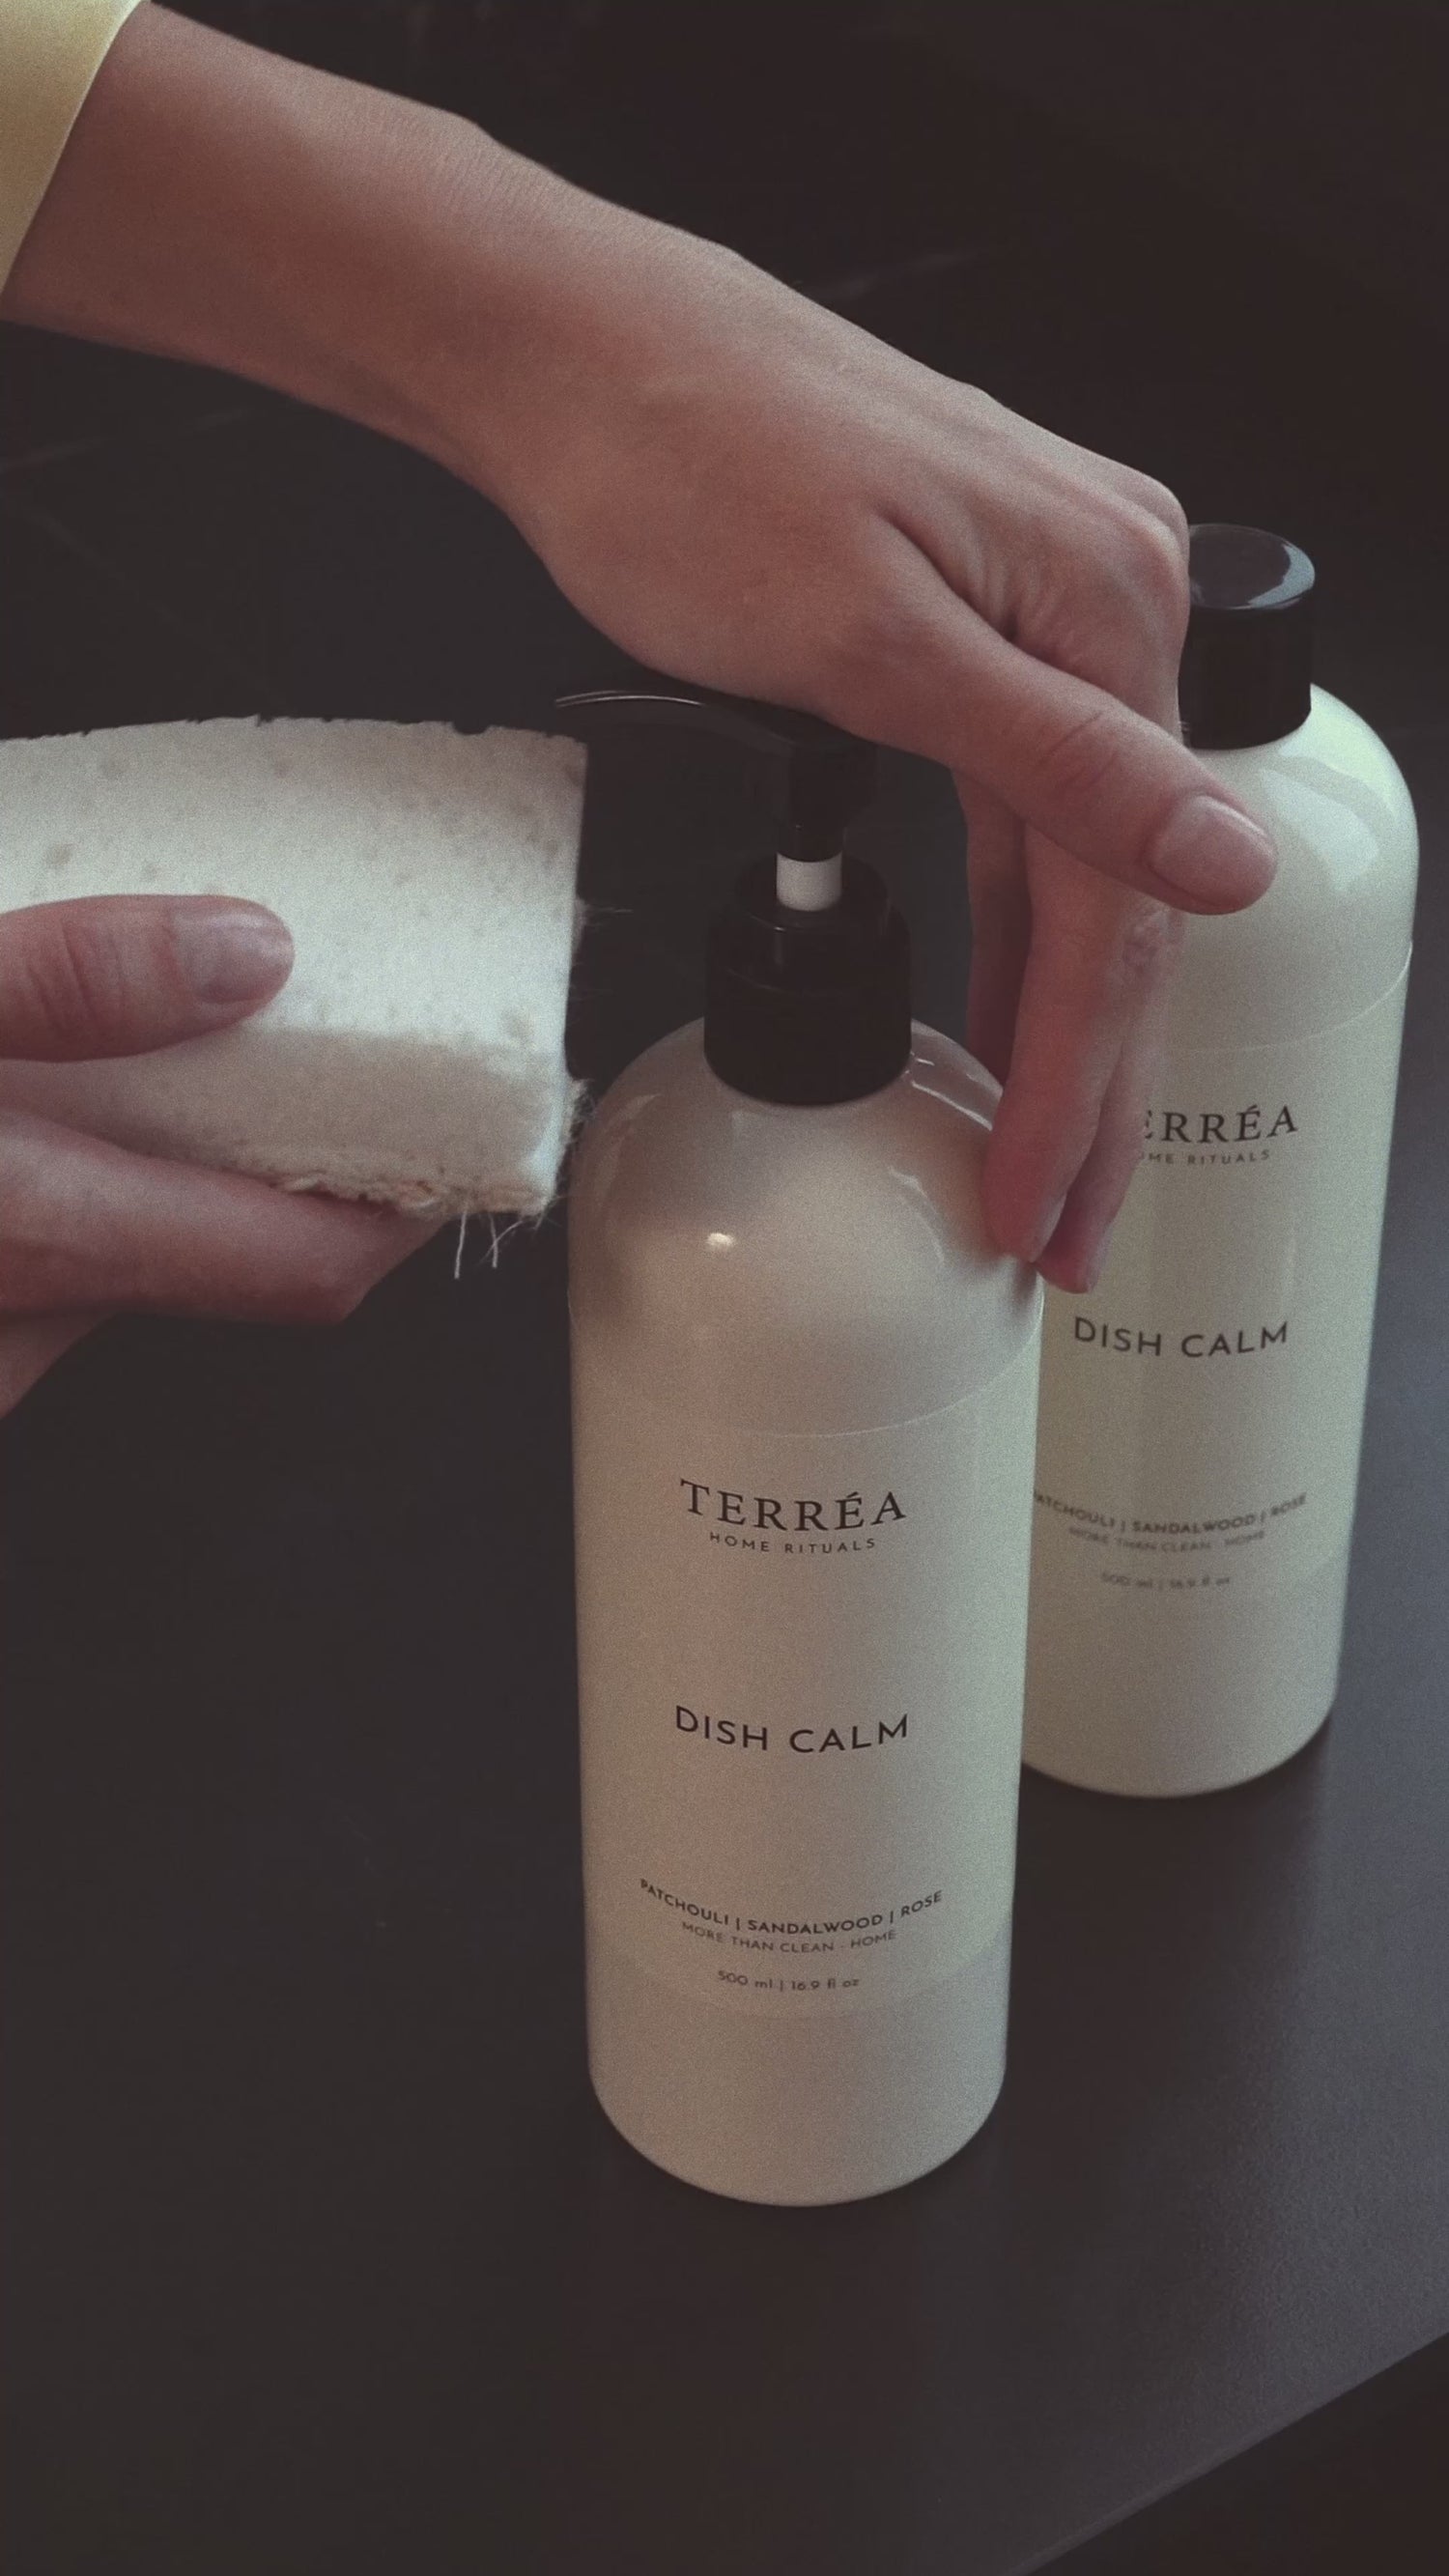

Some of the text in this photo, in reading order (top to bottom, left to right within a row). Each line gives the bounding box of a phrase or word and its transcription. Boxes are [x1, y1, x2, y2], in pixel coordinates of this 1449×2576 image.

[1145, 1104, 1298, 1144] RRÉA
[1187, 1148, 1270, 1165] RITUALS
[1074, 1316, 1288, 1358] DISH CALM
[680, 1479, 906, 1531] TERRÉA
[1132, 1513, 1255, 1535] SANDALWOOD
[710, 1532, 875, 1554] HOME RITUALS
[676, 1705, 908, 1754] DISH CALM
[639, 1879, 728, 1925] PATCHOULI
[748, 1913, 883, 1935] SANDALWOOD
[900, 1889, 943, 1918] ROSE
[682, 1921, 723, 1943] MORE
[730, 1936, 774, 1951] THAN
[780, 1941, 834, 1953] CLEAN
[851, 1931, 895, 1949] HOME
[718, 1969, 748, 1986] 500
[754, 1978, 773, 1989] ml
